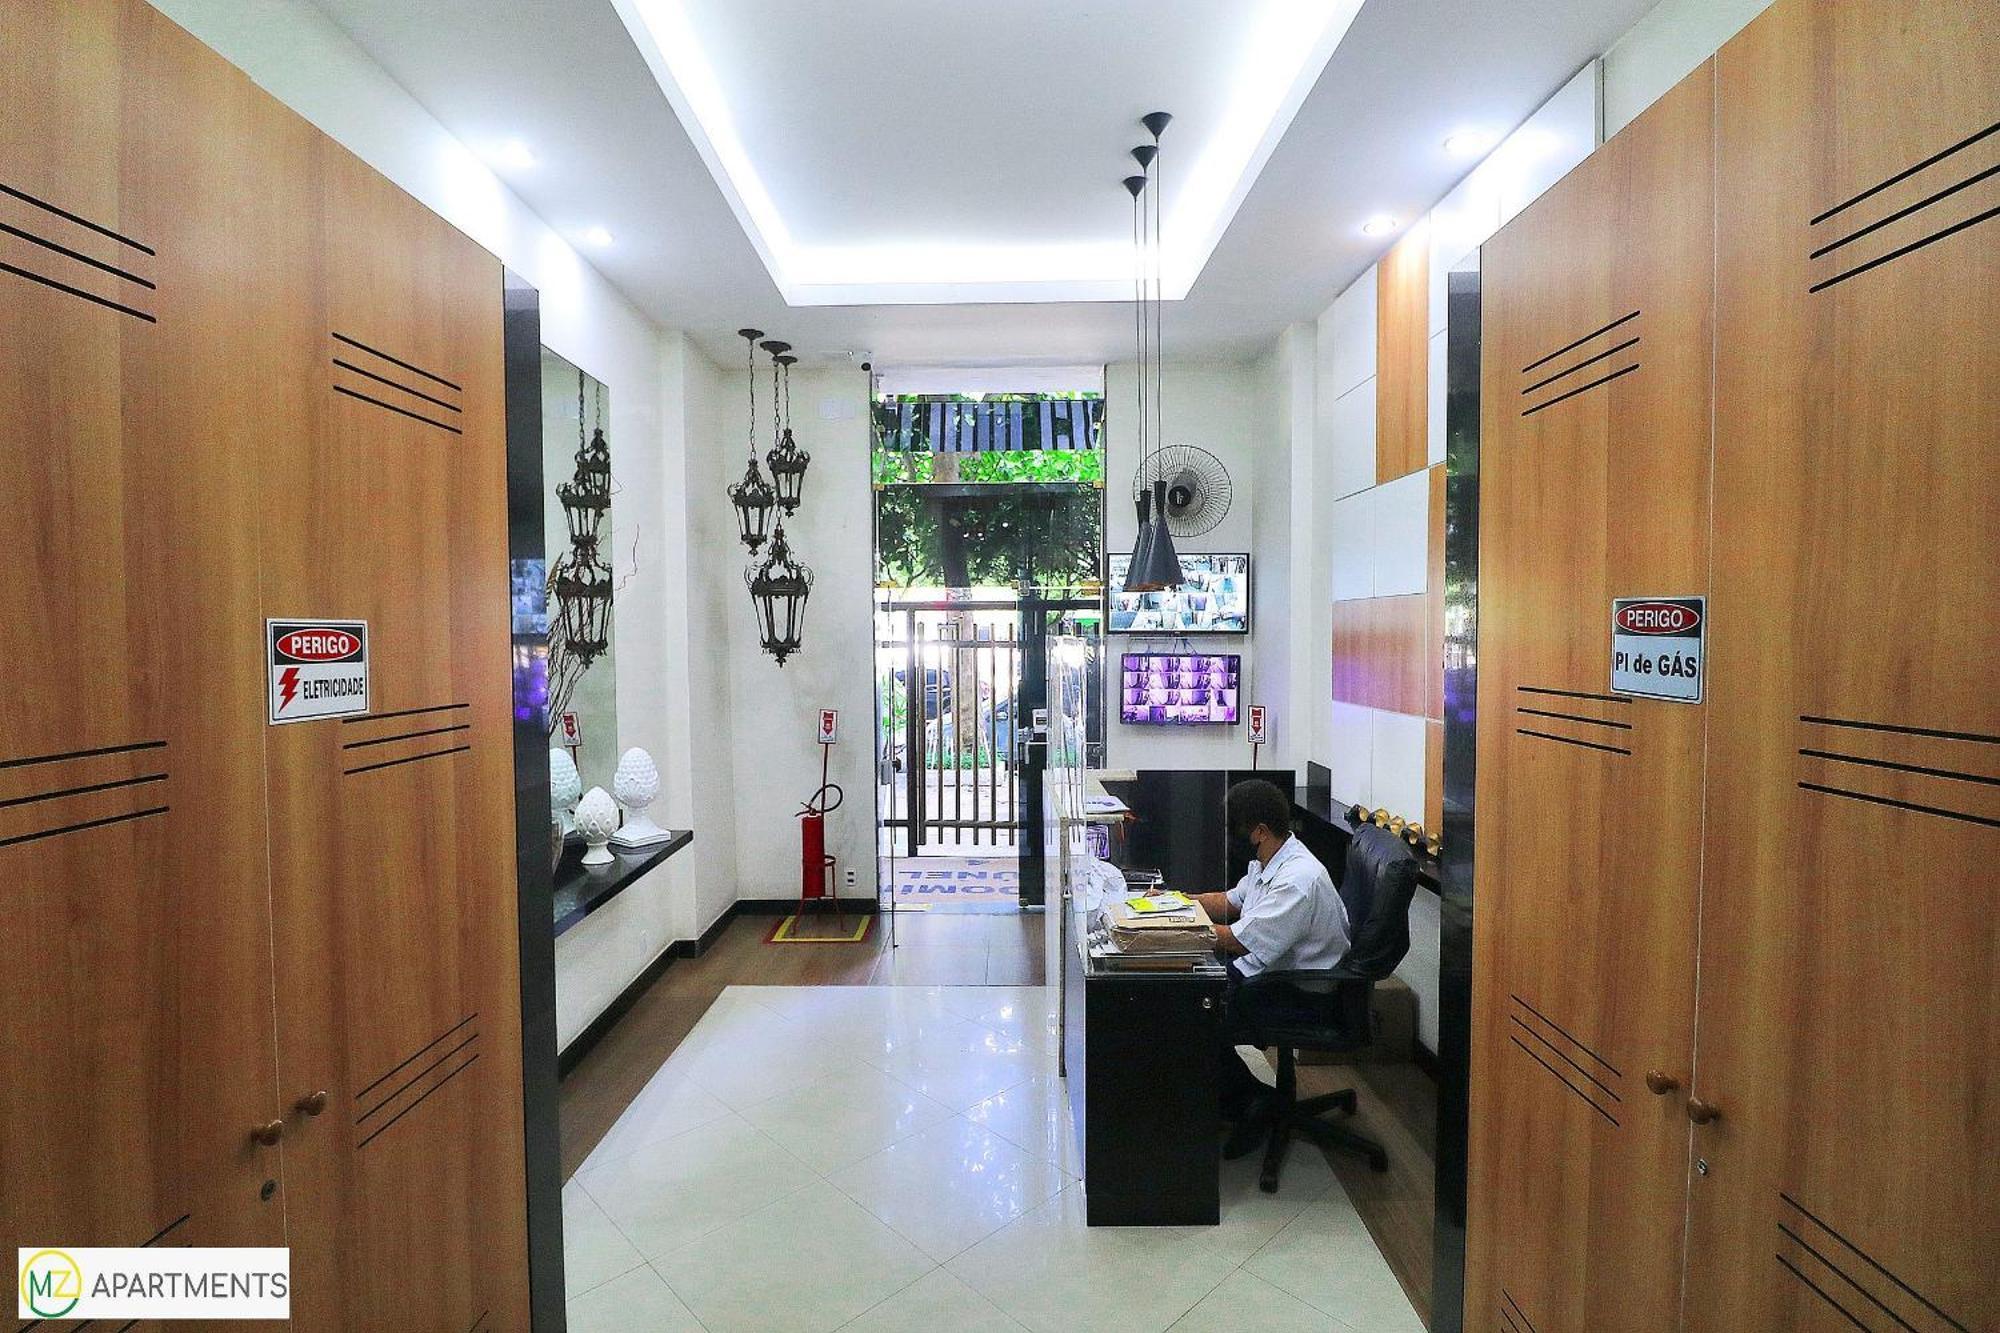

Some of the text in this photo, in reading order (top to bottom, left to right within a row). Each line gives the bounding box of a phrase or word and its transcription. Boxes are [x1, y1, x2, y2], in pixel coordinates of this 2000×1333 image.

[1627, 609, 1683, 628] PERIGO
[291, 635, 350, 655] PERIGO
[1615, 650, 1697, 678] PI de GÁS
[303, 676, 364, 700] ELETRICIDADE
